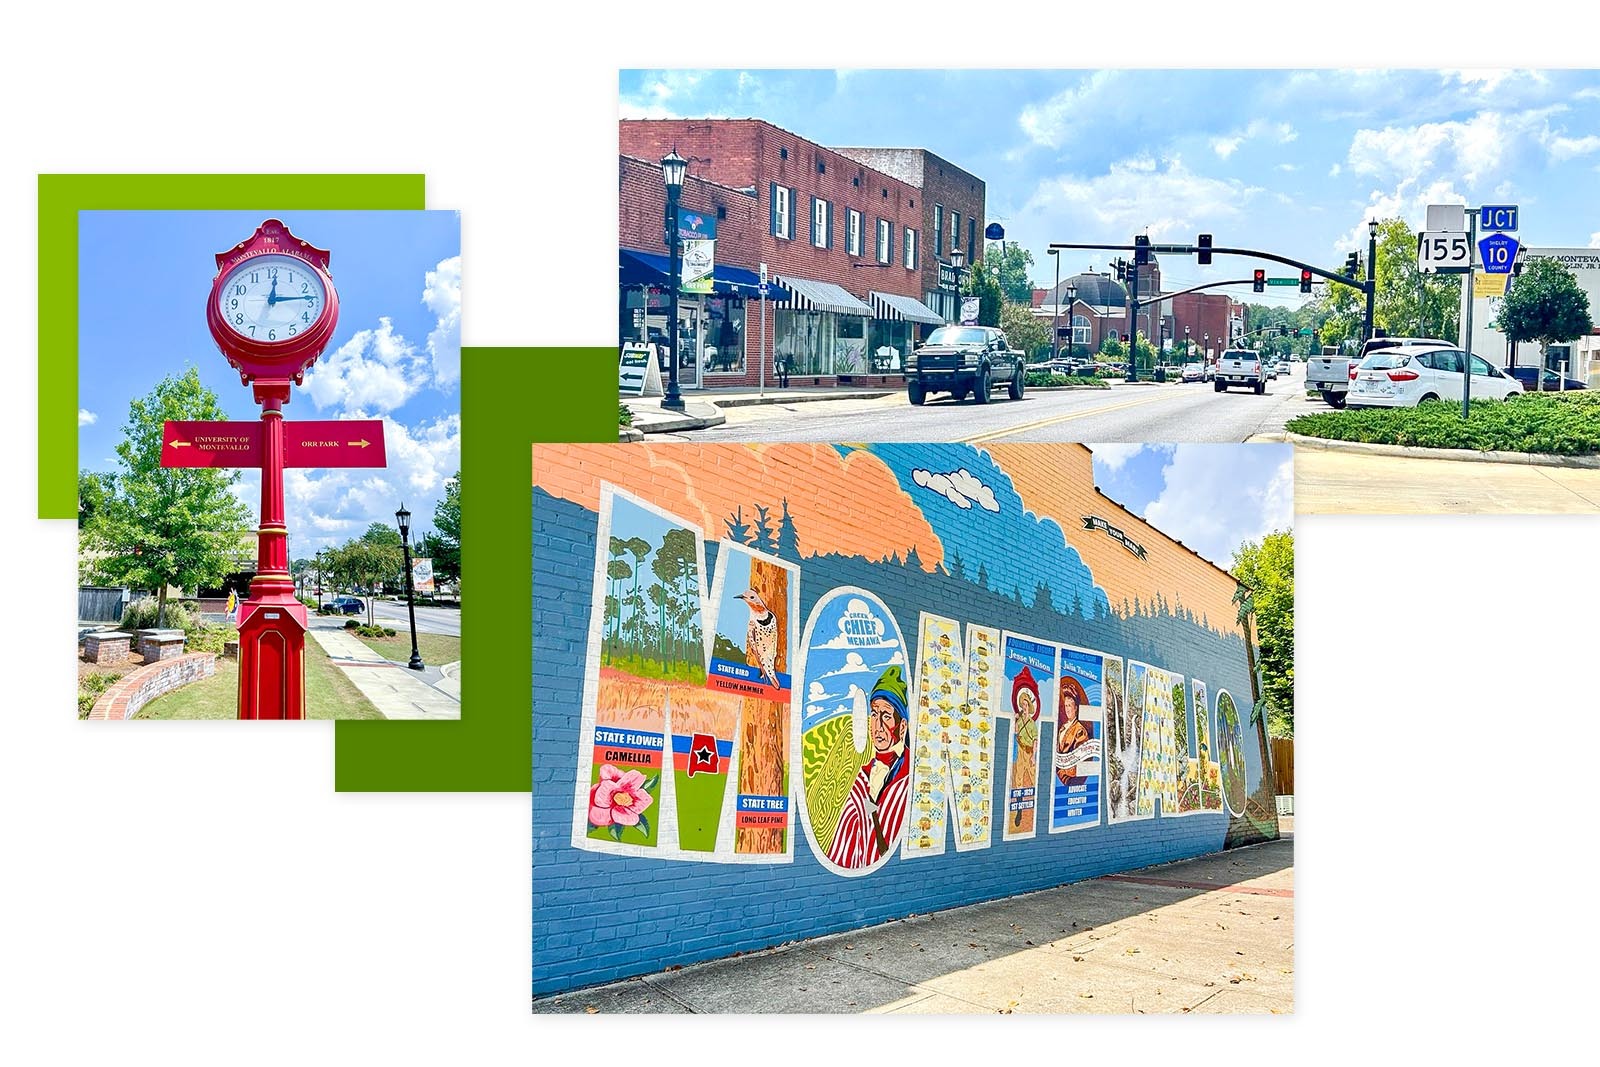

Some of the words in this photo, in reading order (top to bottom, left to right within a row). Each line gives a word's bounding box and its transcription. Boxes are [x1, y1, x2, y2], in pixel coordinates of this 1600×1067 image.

[1483, 209, 1516, 228] JCT
[1423, 238, 1467, 261] 155
[1488, 247, 1508, 263] 10
[251, 272, 259, 283] 11
[267, 268, 278, 279] 12
[289, 272, 293, 283] 1
[236, 285, 247, 296] 10
[301, 283, 308, 293] 2
[231, 299, 238, 310] 9
[307, 298, 314, 308] 3
[236, 313, 244, 325] 8
[301, 311, 309, 323] 4
[248, 325, 256, 337] 7
[268, 329, 276, 341] 6
[288, 324, 297, 336] 5
[844, 619, 877, 635] CHIEF
[847, 636, 880, 646] MENAWA
[1009, 649, 1027, 663] Jesse
[1028, 656, 1051, 671] Wilson
[717, 664, 735, 674] STATE
[735, 668, 750, 677] BIRD
[715, 679, 739, 690] YELLOW
[739, 684, 764, 695] HAMMER
[595, 731, 625, 744] STATE
[626, 734, 664, 747] FLOWER
[605, 750, 652, 764] CAMELLIA
[742, 798, 766, 809] STATE
[766, 799, 784, 810] TREE
[741, 816, 757, 824] LONG
[757, 816, 770, 824] LEAF
[771, 816, 784, 824] PINE
